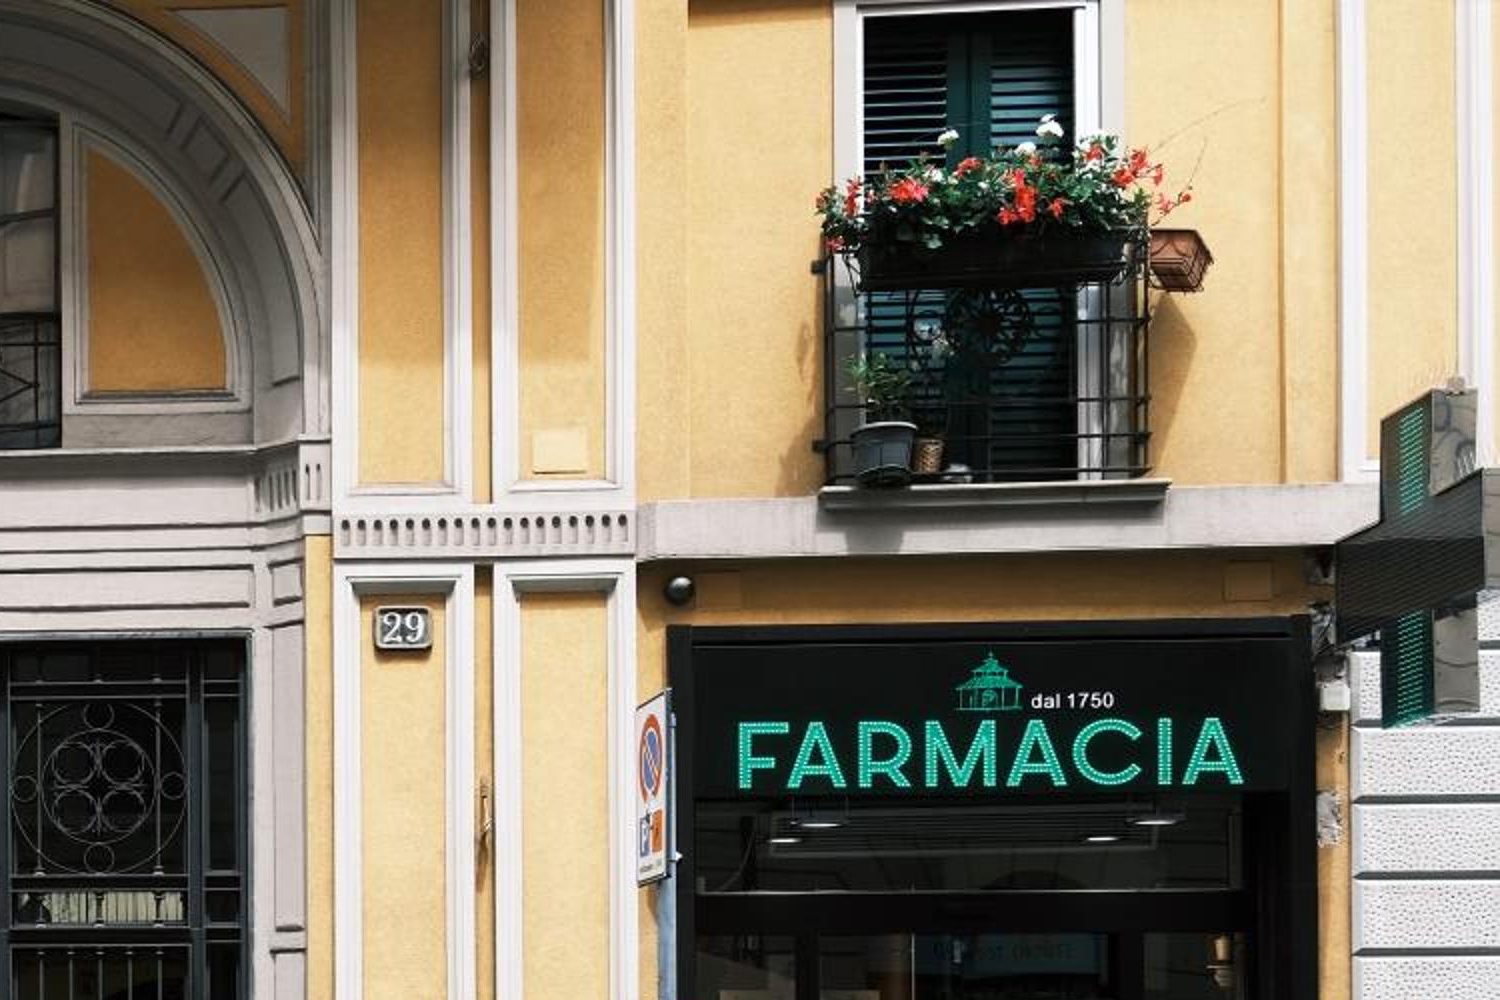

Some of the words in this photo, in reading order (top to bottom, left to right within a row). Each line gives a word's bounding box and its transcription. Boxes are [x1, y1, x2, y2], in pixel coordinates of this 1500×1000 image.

[383, 612, 425, 643] 29
[1031, 692, 1061, 709] dal
[1068, 691, 1115, 708] 1750
[738, 717, 1244, 789] FARMACIA
